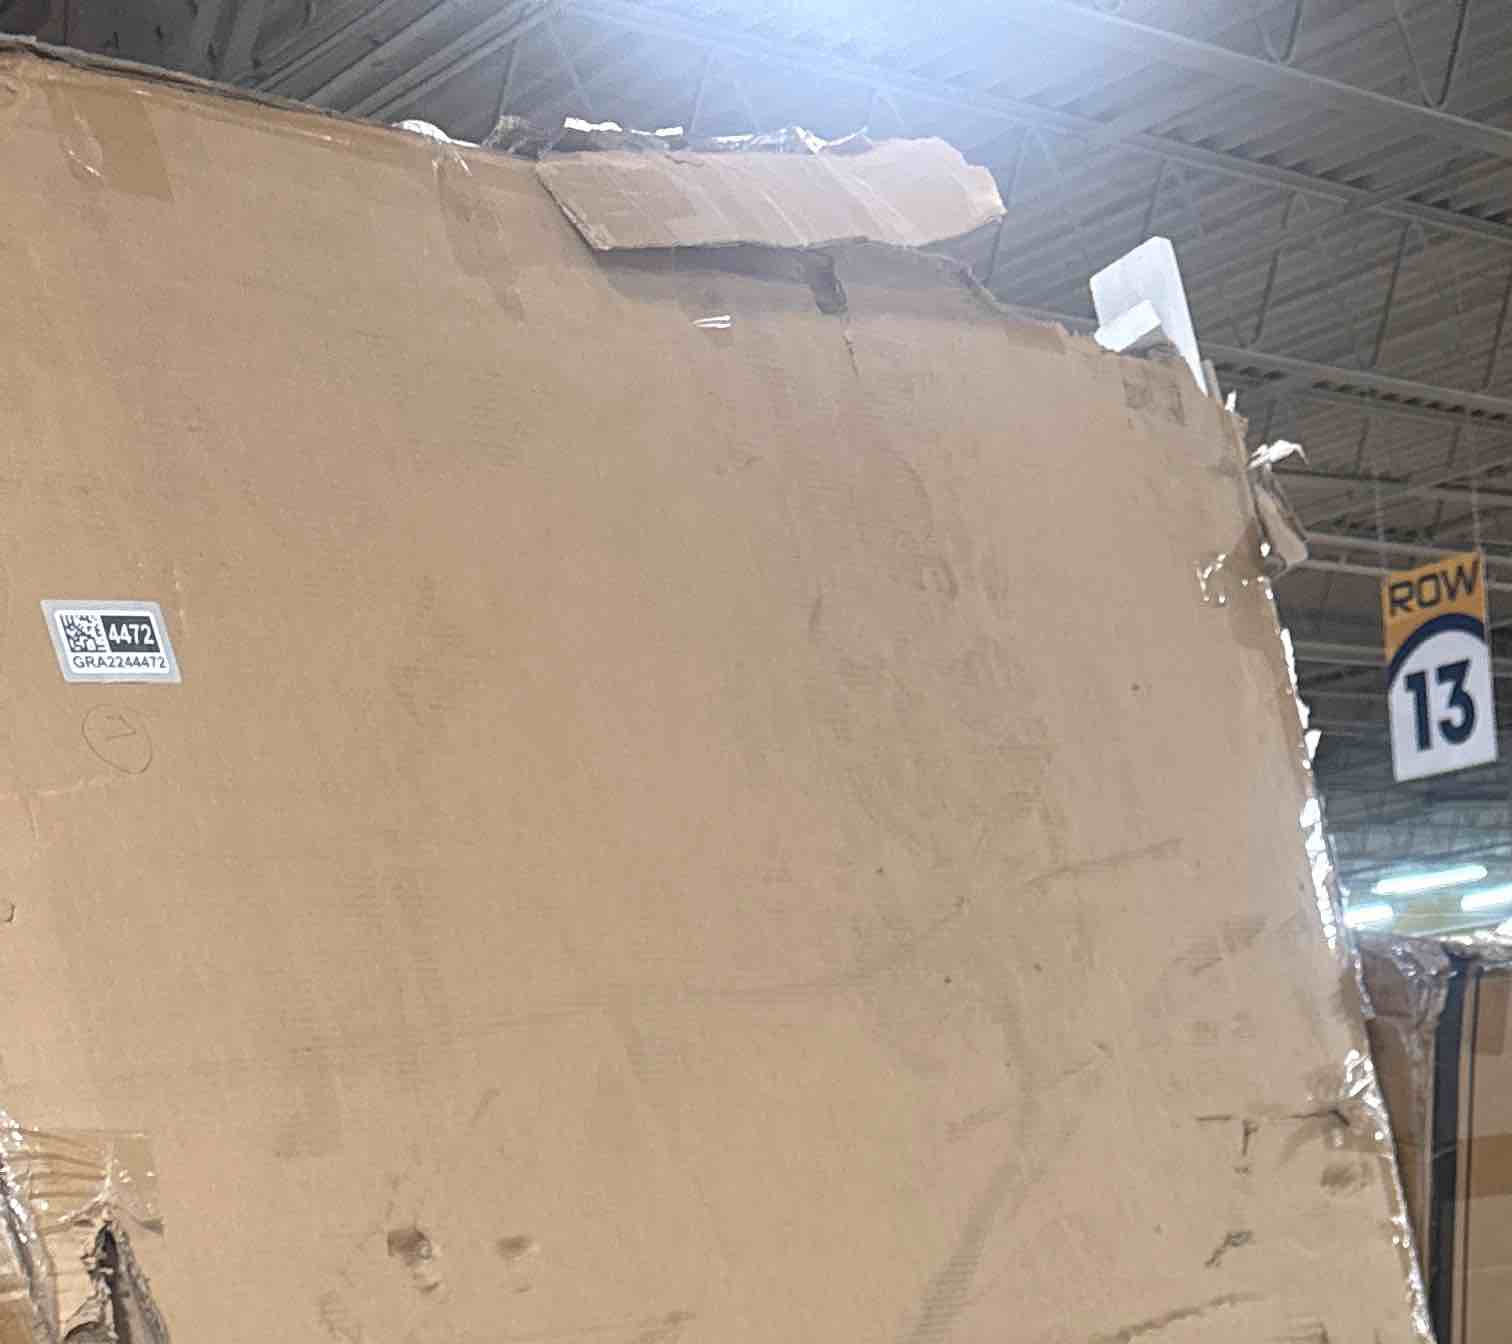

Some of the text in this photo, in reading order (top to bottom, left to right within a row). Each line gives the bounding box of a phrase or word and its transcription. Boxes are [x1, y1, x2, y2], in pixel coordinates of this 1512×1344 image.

[1390, 559, 1479, 617] ROW
[108, 623, 156, 646] 4472
[72, 654, 168, 670] GRA2244472
[1404, 658, 1477, 752] 13
